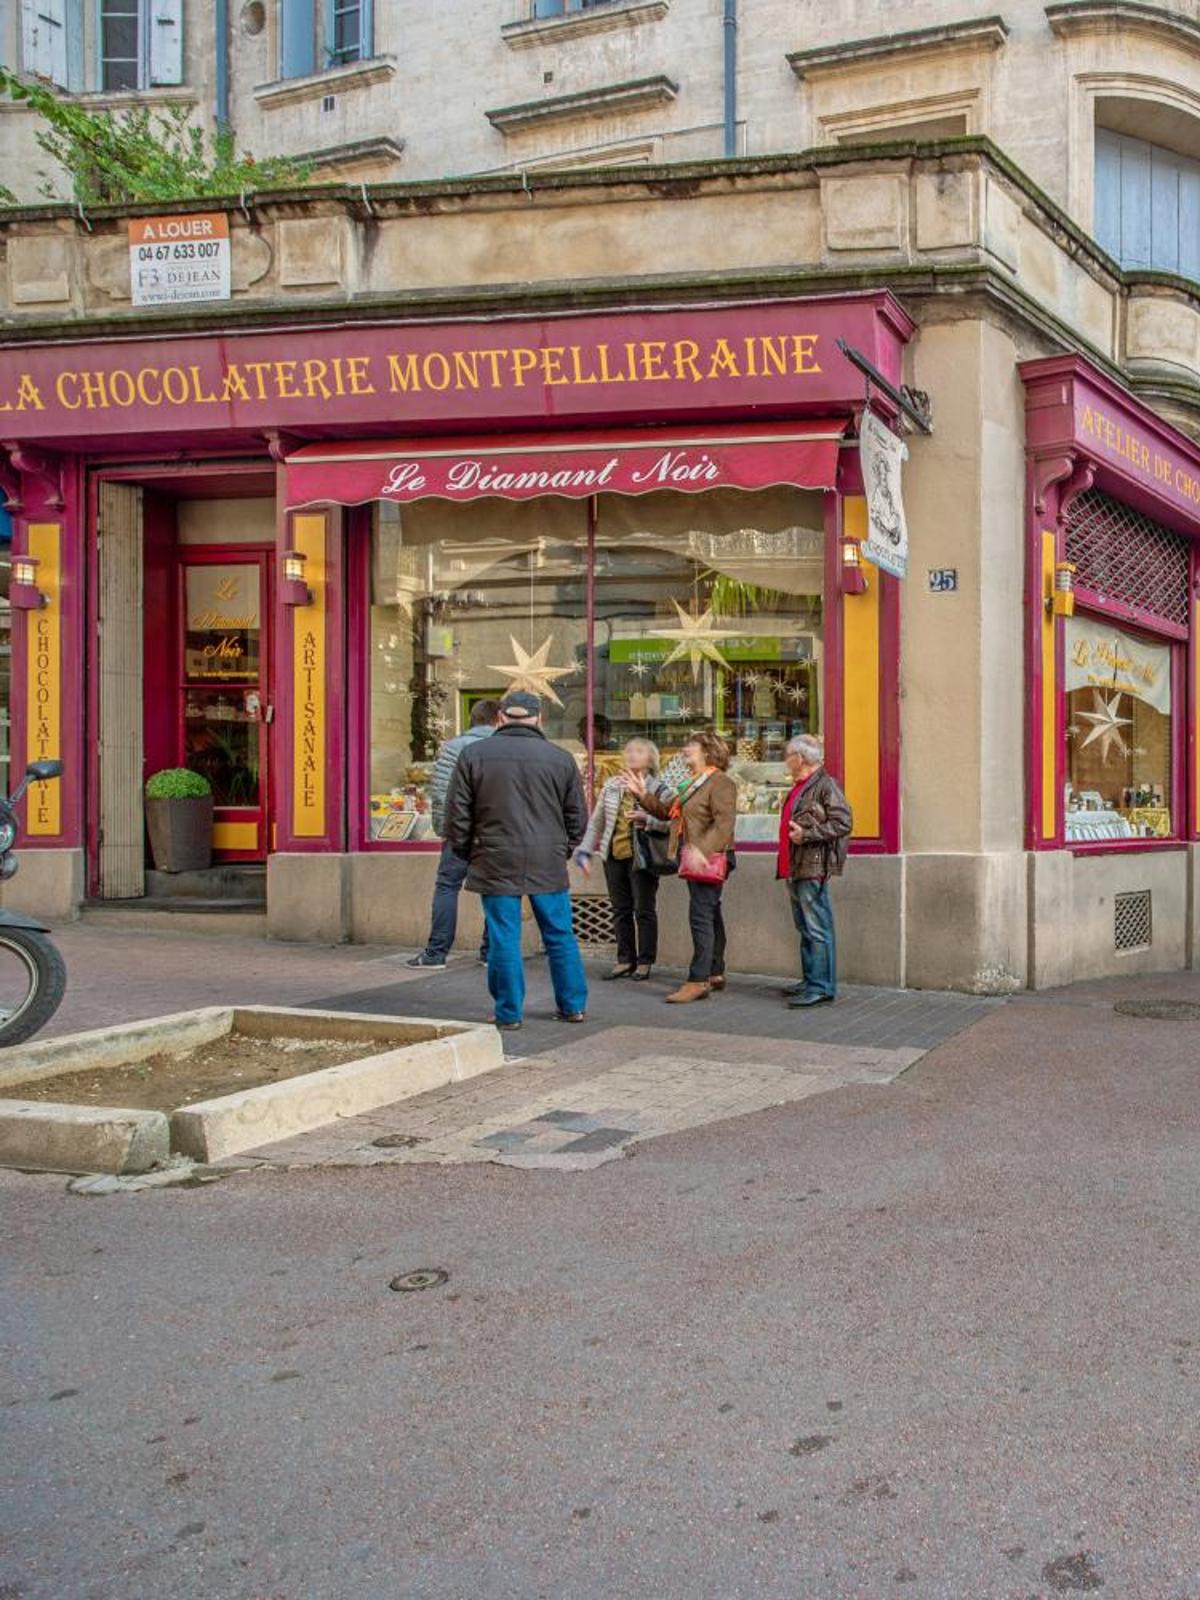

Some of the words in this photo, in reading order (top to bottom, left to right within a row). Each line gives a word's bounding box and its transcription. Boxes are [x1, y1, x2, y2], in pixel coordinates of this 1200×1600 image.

[143, 223, 155, 240] A
[159, 219, 213, 238] LOUER
[138, 247, 153, 261] 04
[156, 245, 170, 260] 67
[173, 243, 195, 259] 633
[198, 242, 220, 258] 007
[167, 269, 221, 284] DEJEAN
[56, 356, 376, 410] CHOCOLATERIE
[387, 333, 823, 393] MONTPELLIERAINE
[1082, 404, 1150, 473] ATELIER
[1153, 454, 1172, 486] DE
[382, 463, 426, 494] Le
[447, 457, 619, 493] Diamant
[632, 450, 720, 484] Noir
[930, 570, 955, 591] 25
[202, 635, 244, 658] Noir
[37, 619, 50, 824] CHOCOLATIE
[303, 631, 316, 808] ARTISANALE
